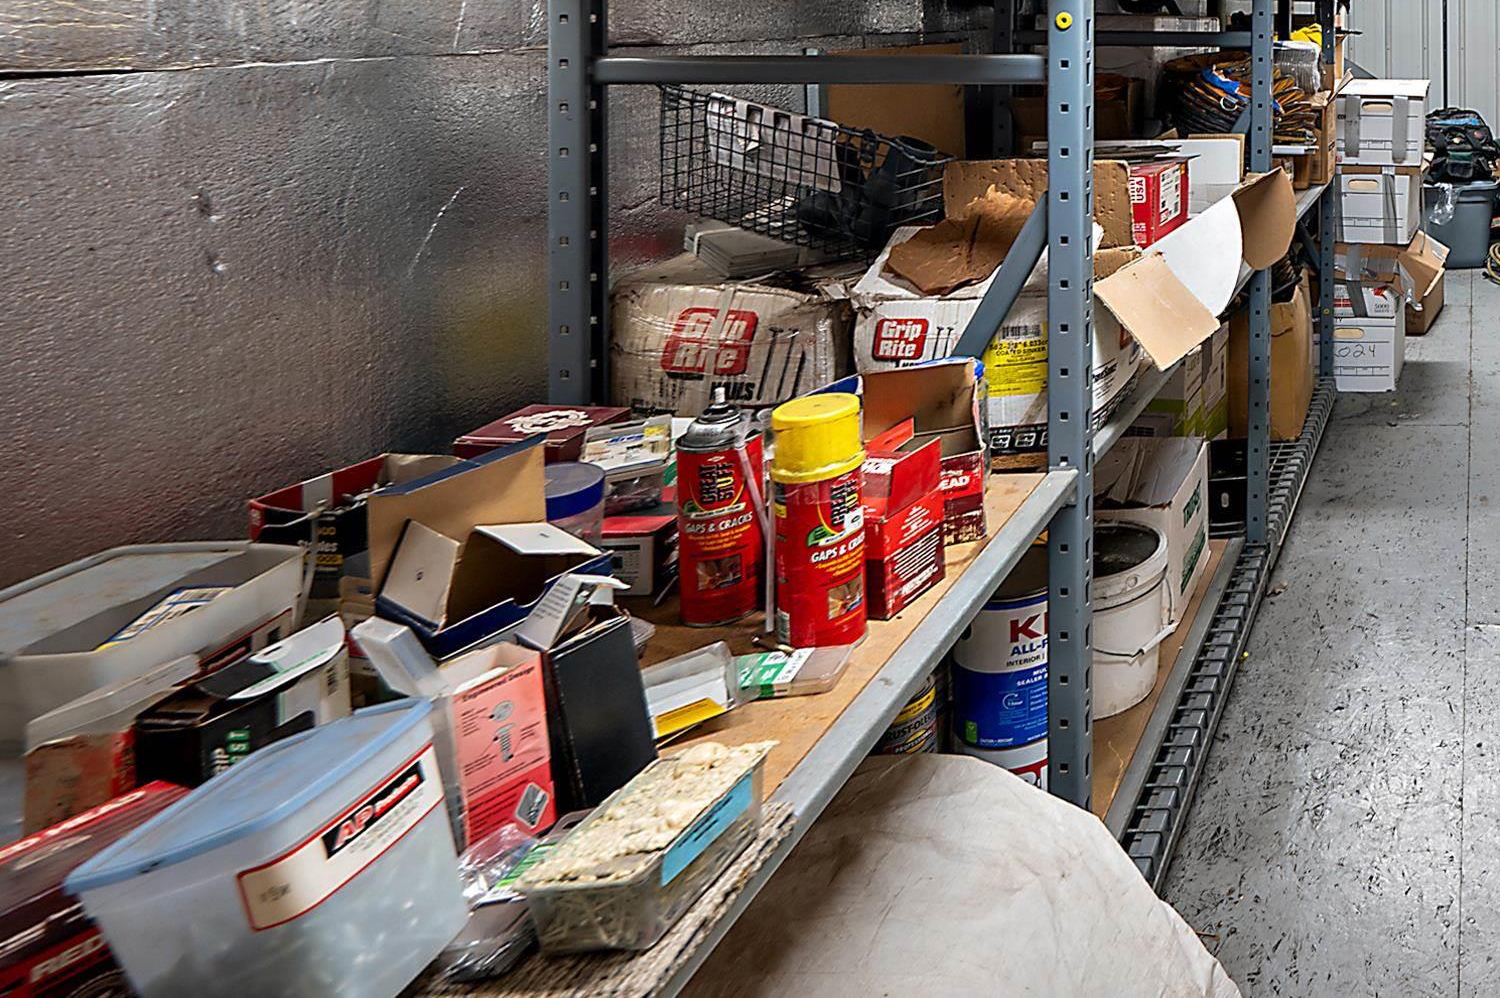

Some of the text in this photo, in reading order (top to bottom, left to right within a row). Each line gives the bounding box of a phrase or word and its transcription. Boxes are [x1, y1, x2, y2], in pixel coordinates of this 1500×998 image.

[1135, 179, 1145, 202] USA
[681, 311, 748, 343] Gip
[881, 321, 923, 341] Grip
[672, 342, 738, 370] Rie
[878, 339, 917, 358] Rite
[1335, 344, 1375, 358] 024
[700, 464, 717, 503] GREAT
[716, 462, 735, 502] STUFF
[830, 480, 846, 526] GREAT
[685, 522, 706, 533] GAPS
[718, 512, 753, 531] CRACKS
[811, 547, 838, 563] GAPS
[839, 544, 847, 555] &
[1006, 656, 1040, 667] INTERIOR
[462, 666, 535, 702] Engineered Design
[1016, 675, 1042, 687] SEALER
